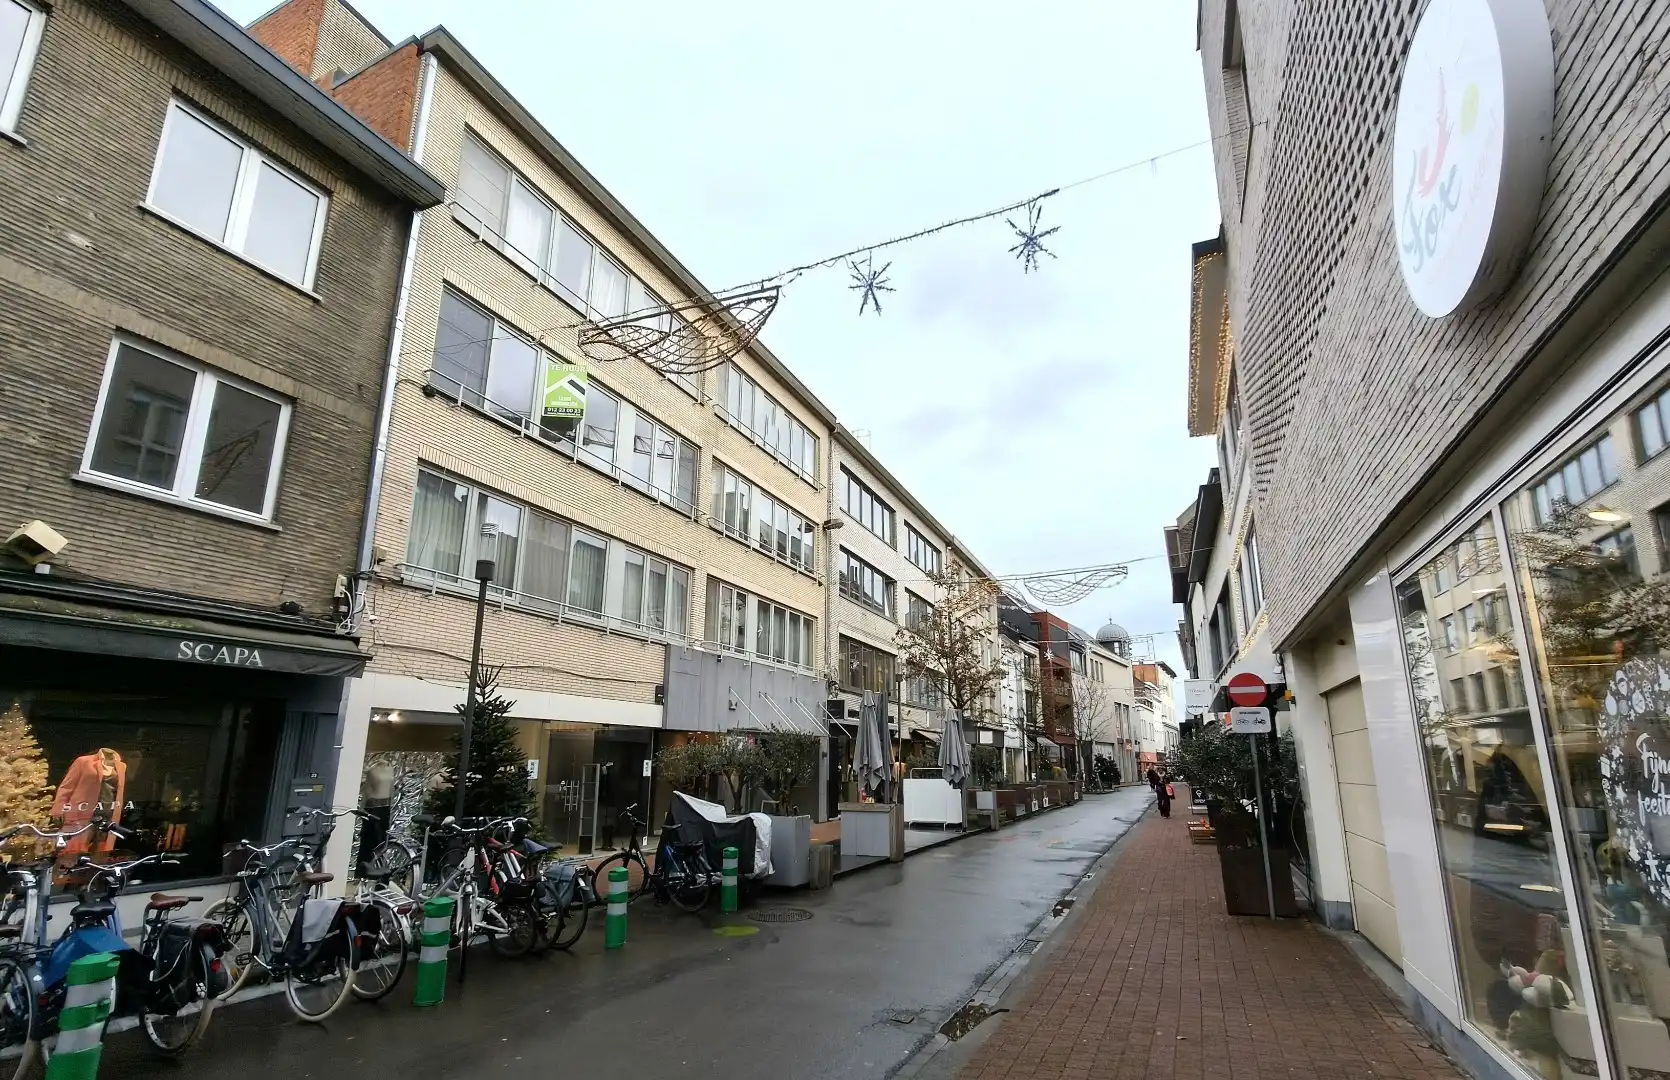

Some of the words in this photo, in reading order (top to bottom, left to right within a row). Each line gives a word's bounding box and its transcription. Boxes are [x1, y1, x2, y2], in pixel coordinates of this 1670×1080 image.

[178, 641, 263, 667] SCAPA
[62, 800, 135, 812] SCAPA
[1638, 782, 1670, 826] feest
